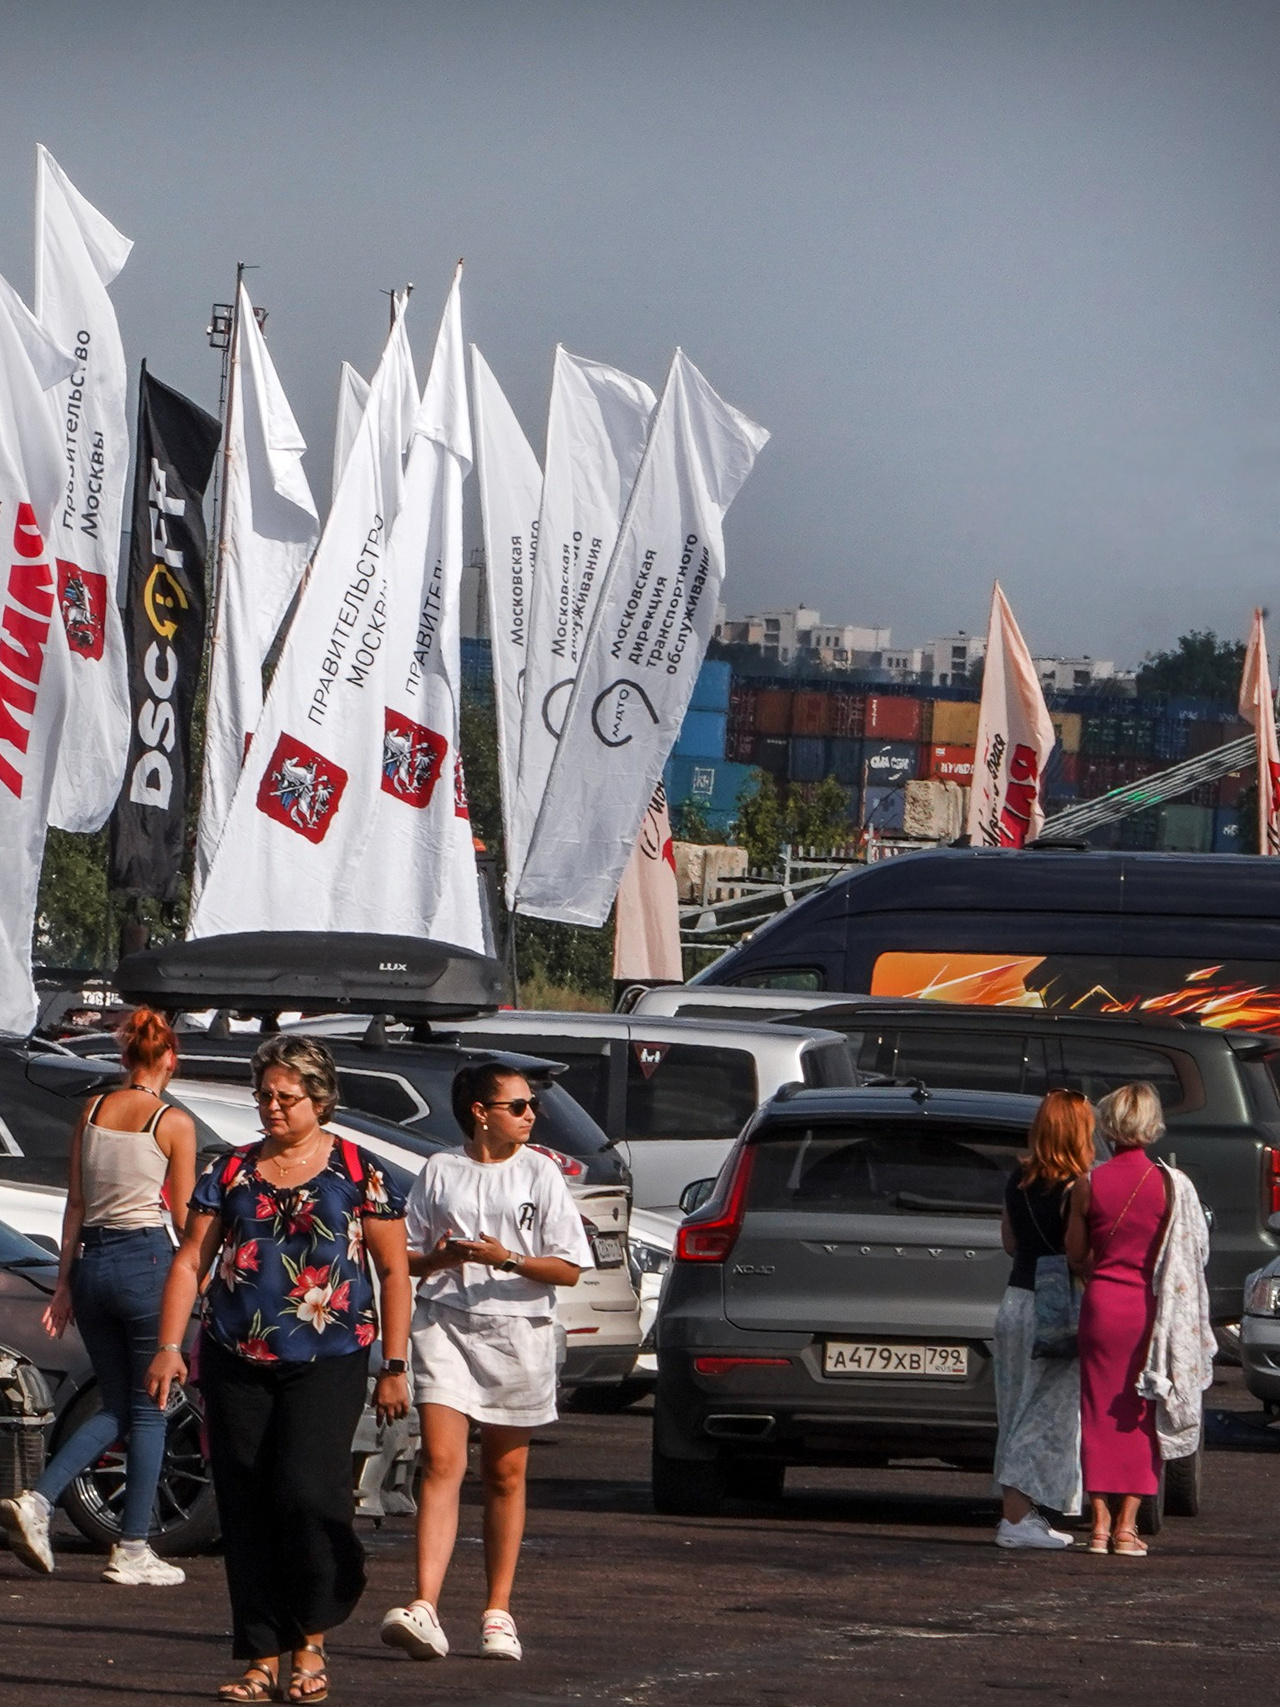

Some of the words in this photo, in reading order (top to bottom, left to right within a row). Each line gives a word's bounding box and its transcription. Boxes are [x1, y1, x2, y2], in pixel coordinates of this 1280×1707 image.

[80, 430, 104, 540] Москвы
[510, 535, 524, 647] Московская
[611, 549, 657, 659] Московская
[628, 576, 667, 666] дирекция
[646, 533, 698, 668] транспортного
[379, 962, 407, 971] LUX
[823, 1244, 975, 1259] VOLVO
